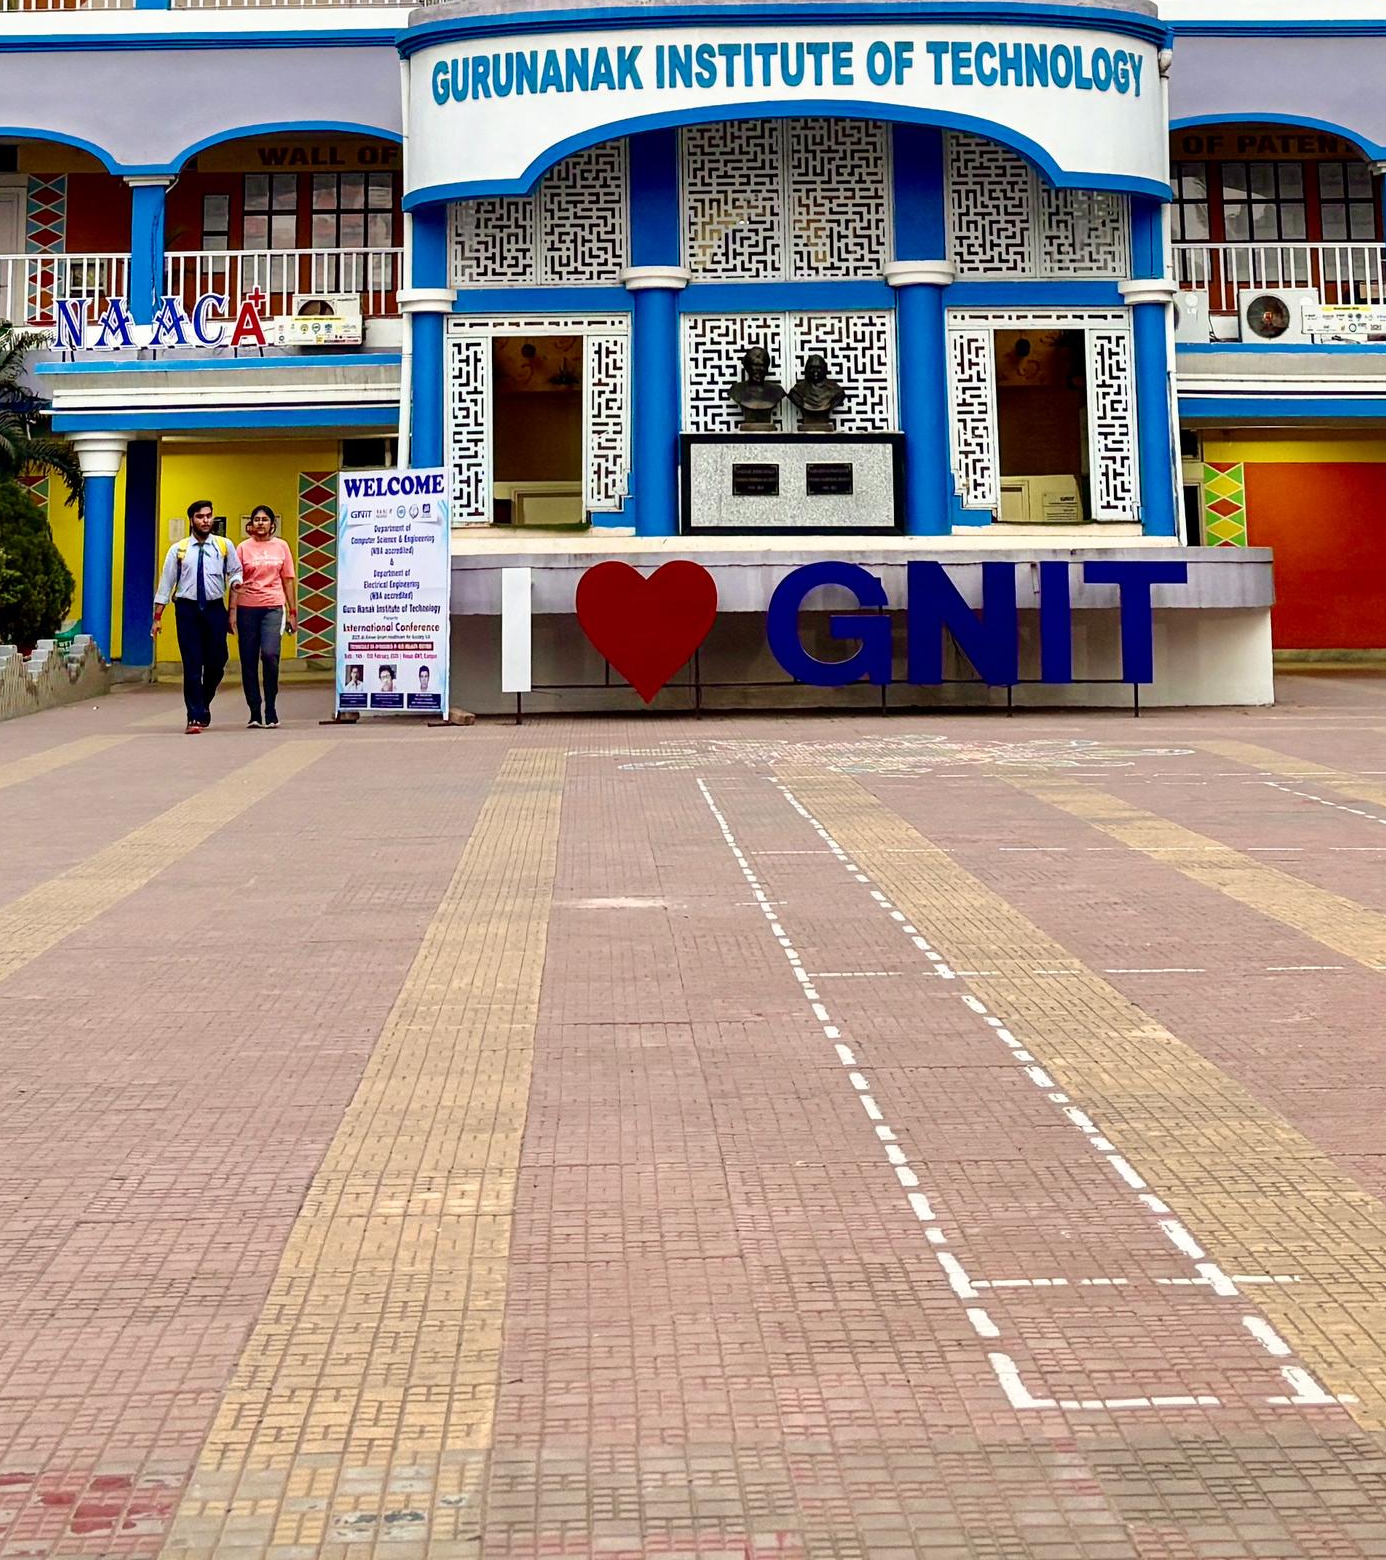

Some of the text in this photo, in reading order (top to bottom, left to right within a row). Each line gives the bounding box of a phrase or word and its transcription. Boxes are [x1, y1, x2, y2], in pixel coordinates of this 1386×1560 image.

[432, 41, 1144, 105] GURUNANAK INSTITUTE OF TECHNOLOGY
[1182, 135, 1223, 154] OF
[257, 145, 399, 166] WALL OF
[50, 293, 230, 351] NAAC
[343, 474, 445, 498] WELCOME
[350, 510, 373, 519] GNIT
[374, 523, 412, 534] Department of
[351, 536, 376, 545] Computer
[376, 536, 397, 544] Science
[404, 534, 435, 544] Engineering
[373, 568, 411, 578] Department of
[363, 580, 420, 590] Electrical Engineering
[342, 605, 356, 614] Guru
[376, 604, 400, 613] Institute
[401, 603, 408, 612] of
[409, 603, 441, 614] Technology
[343, 622, 440, 632] International Conference
[501, 560, 1188, 692] I GNIT
